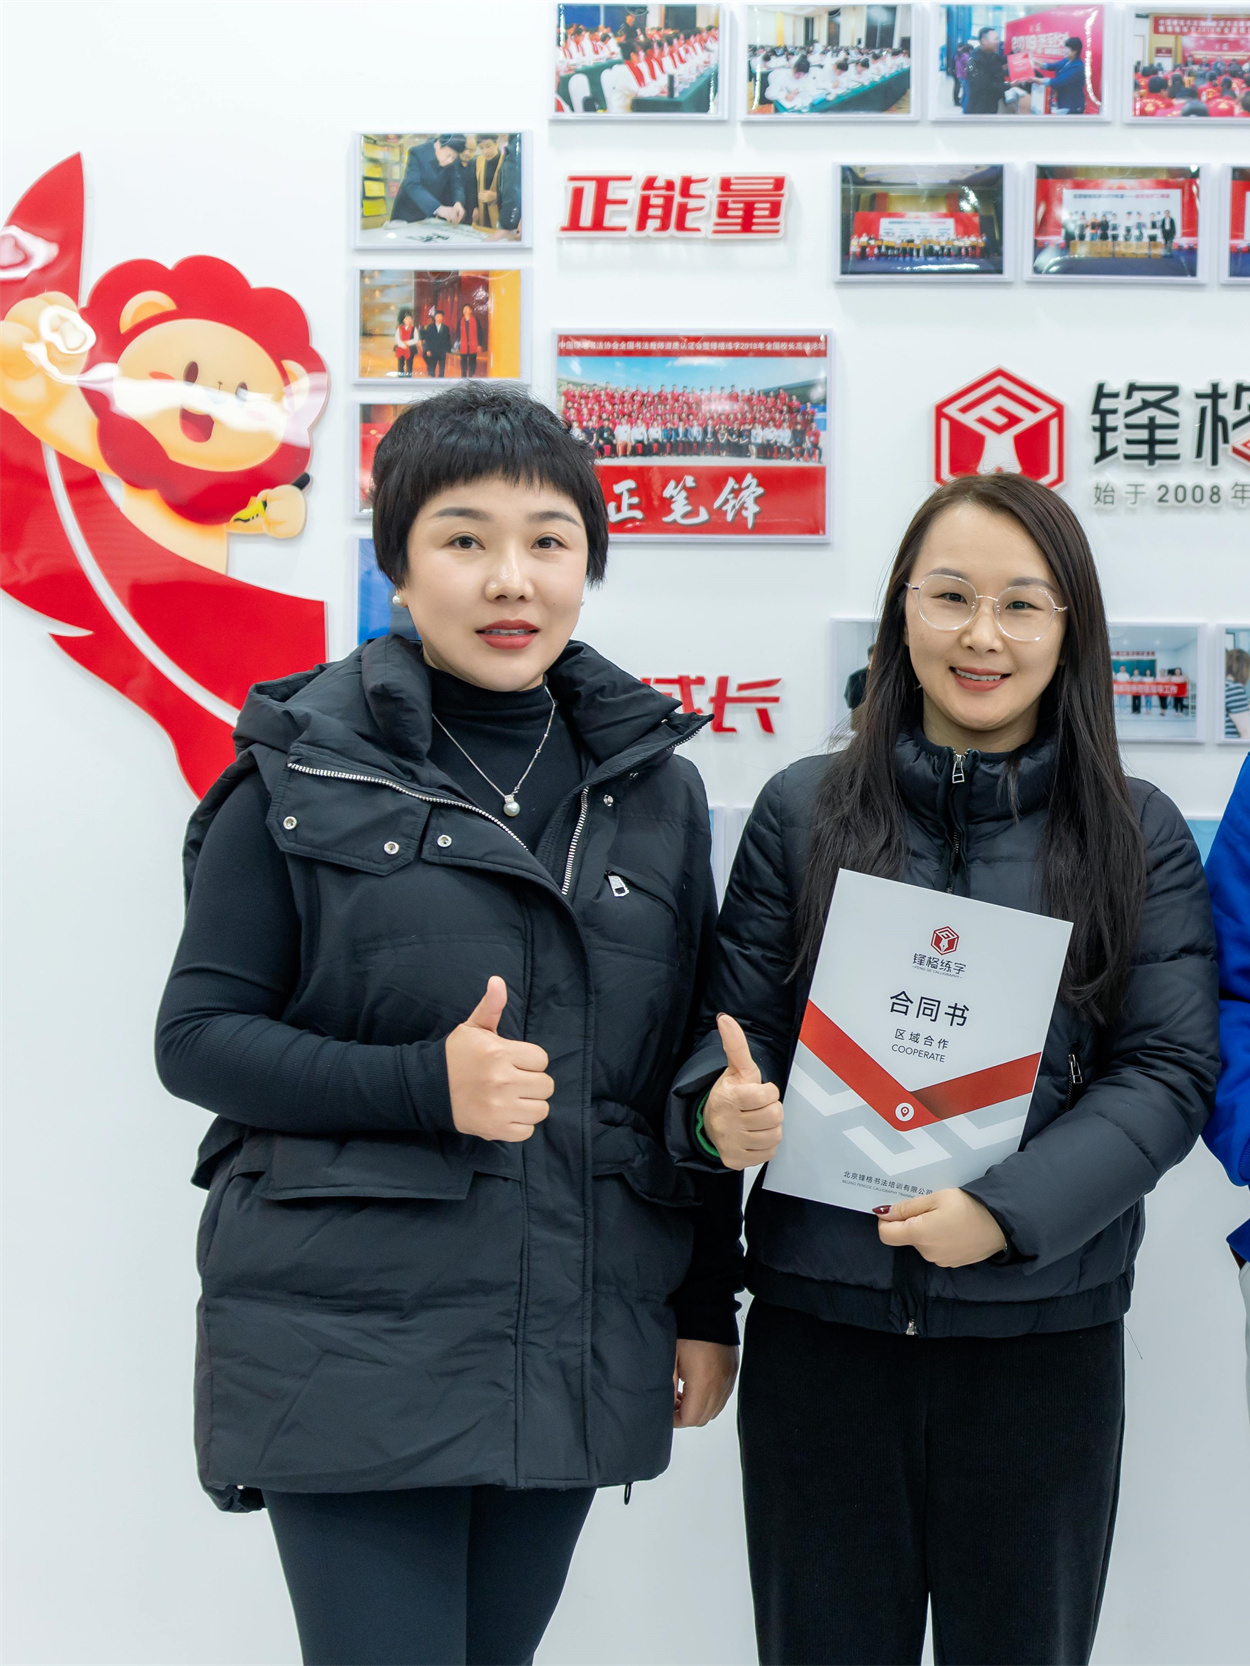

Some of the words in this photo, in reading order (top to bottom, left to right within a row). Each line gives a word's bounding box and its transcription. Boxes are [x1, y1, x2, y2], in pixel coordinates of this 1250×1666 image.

[560, 176, 785, 234] 正能量
[607, 473, 765, 529] 正笔锋
[913, 953, 966, 975] 锋格练字
[889, 990, 970, 1027] 合同书
[894, 1028, 949, 1050] 区域合作
[891, 1044, 946, 1063] COOPERATE
[843, 1171, 933, 1196] 北京锋格书法培训有限公司
